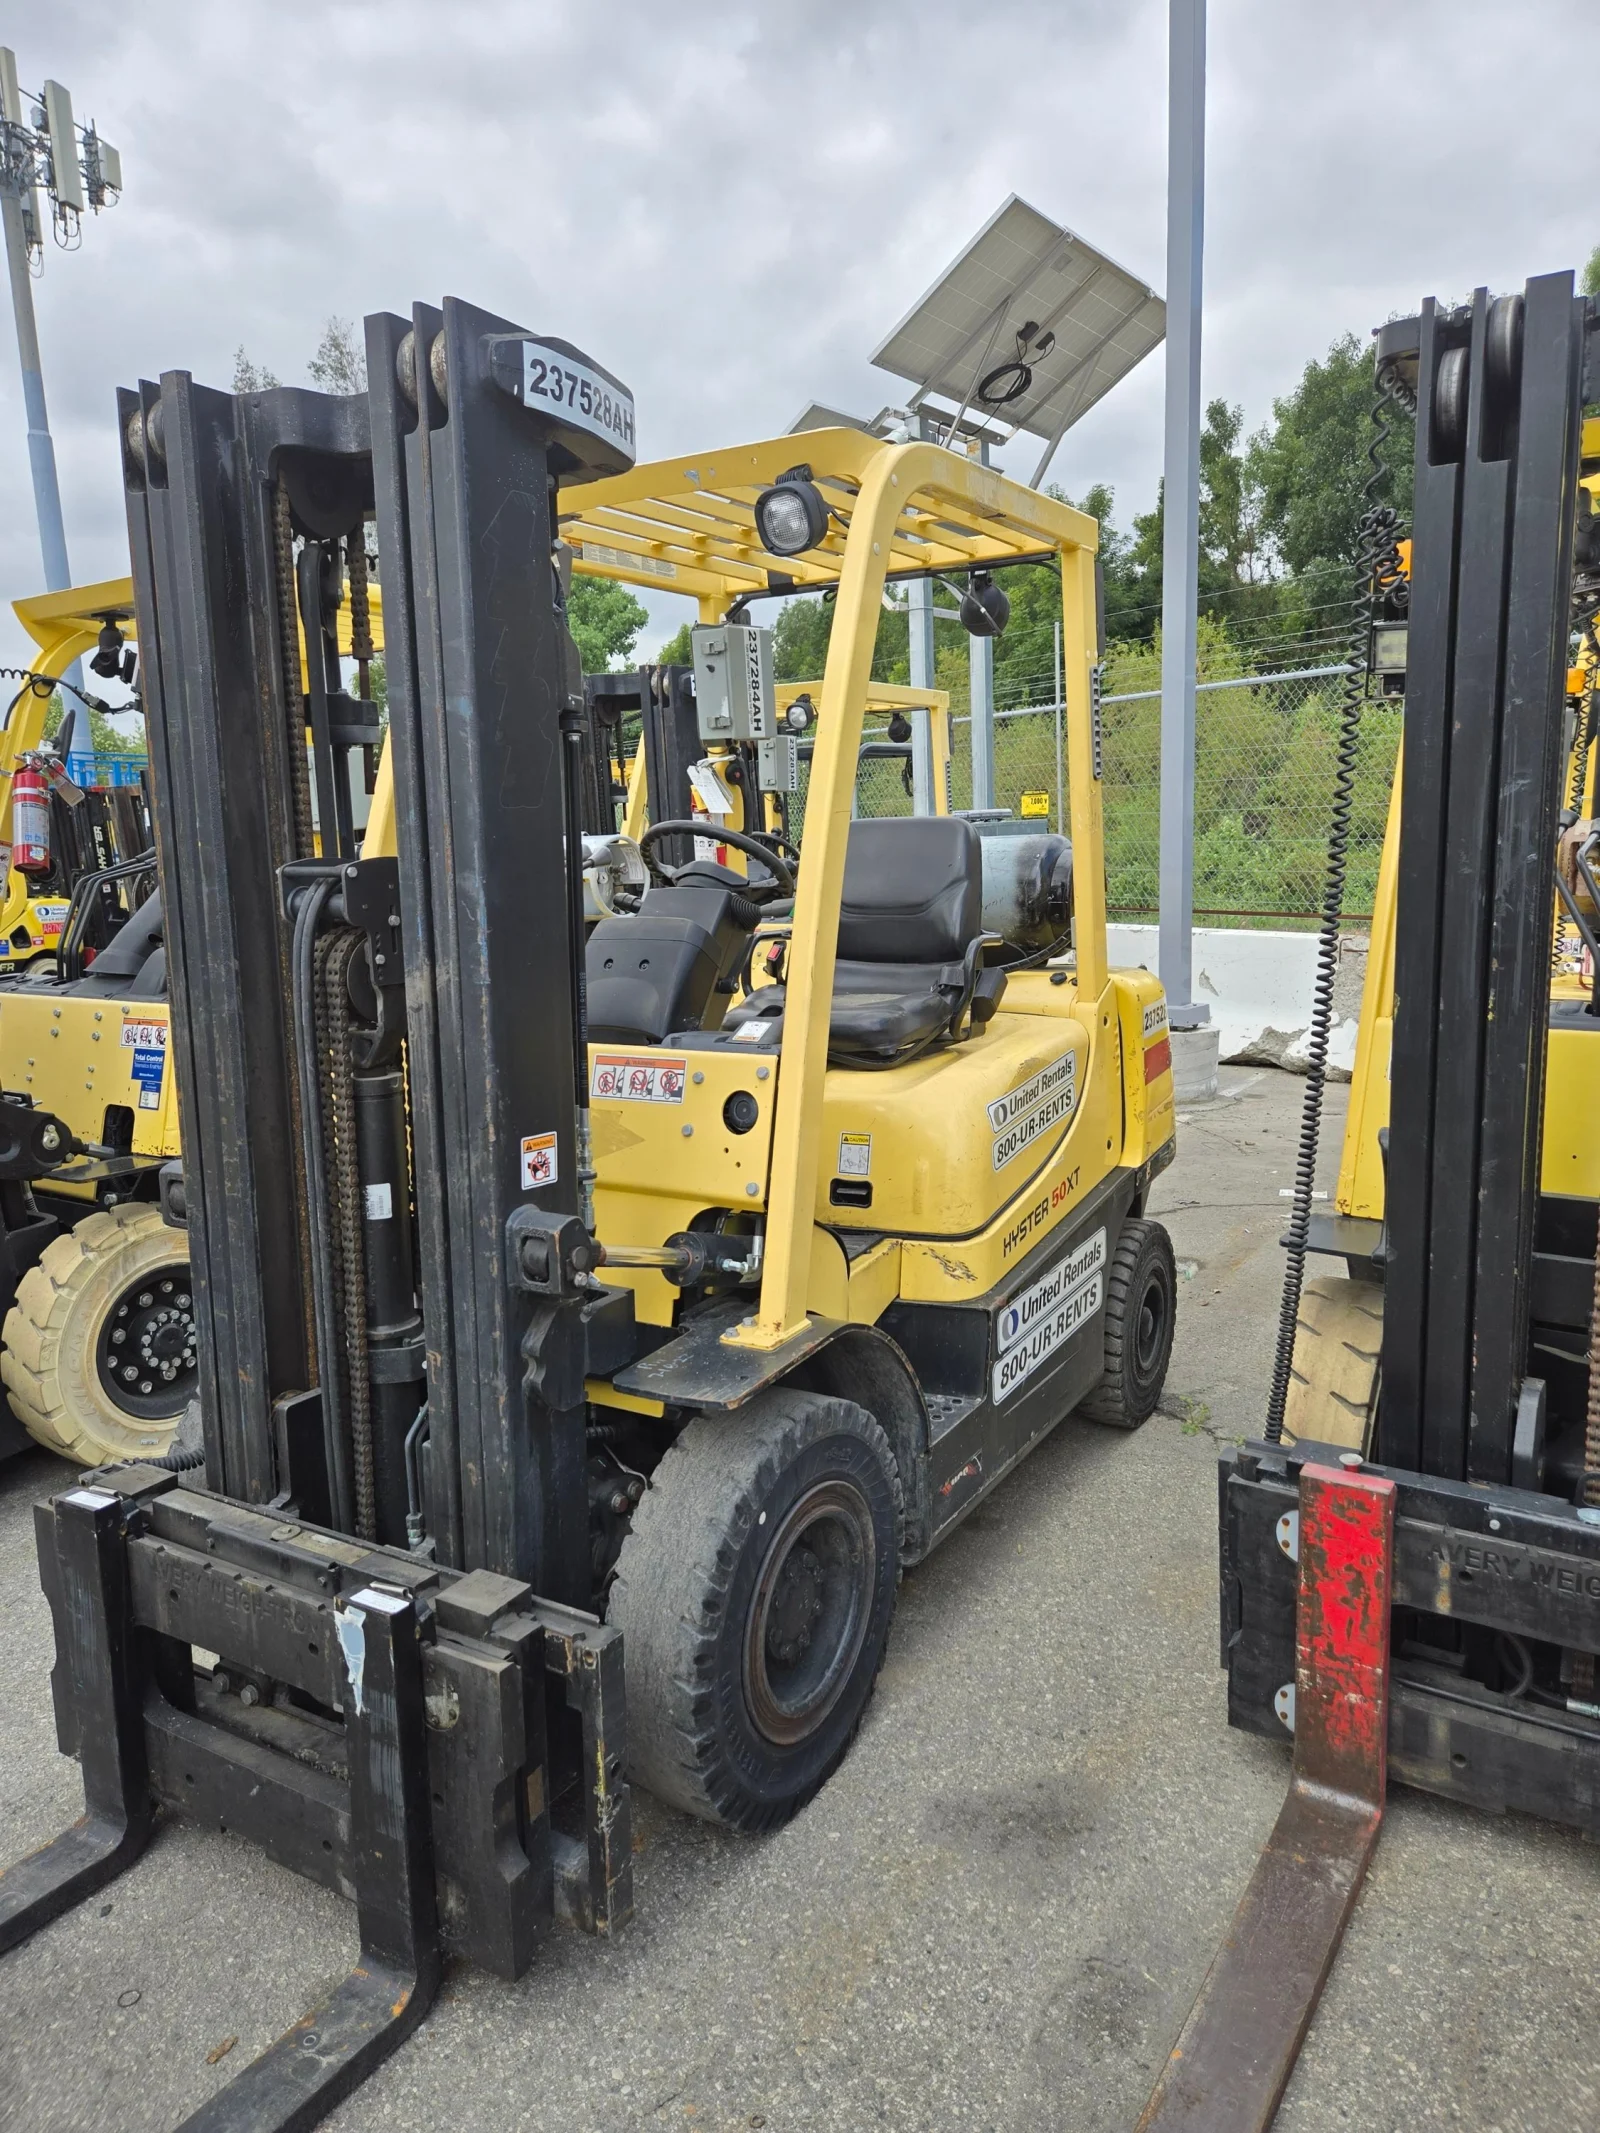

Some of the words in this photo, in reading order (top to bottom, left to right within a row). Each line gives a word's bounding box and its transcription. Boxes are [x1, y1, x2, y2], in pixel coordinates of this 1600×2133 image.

[530, 358, 634, 446] 237528AH
[748, 630, 762, 732] 237284AH
[93, 825, 107, 869] HYSTER
[135, 1053, 146, 1061] Total
[146, 1054, 163, 1062] Control
[1009, 1079, 1040, 1116] United
[1041, 1058, 1073, 1093] Rentals
[997, 1088, 1072, 1164] 800-UR-RENTS
[1003, 1197, 1049, 1258] HYSTER
[1051, 1165, 1081, 1209] 50XT
[1021, 1271, 1061, 1325] United
[1063, 1240, 1102, 1289] Rentals
[999, 1282, 1098, 1390] 800-UR-RENTS
[1428, 1542, 1521, 1580] AVERY
[1530, 1561, 1600, 1600] WEIG
